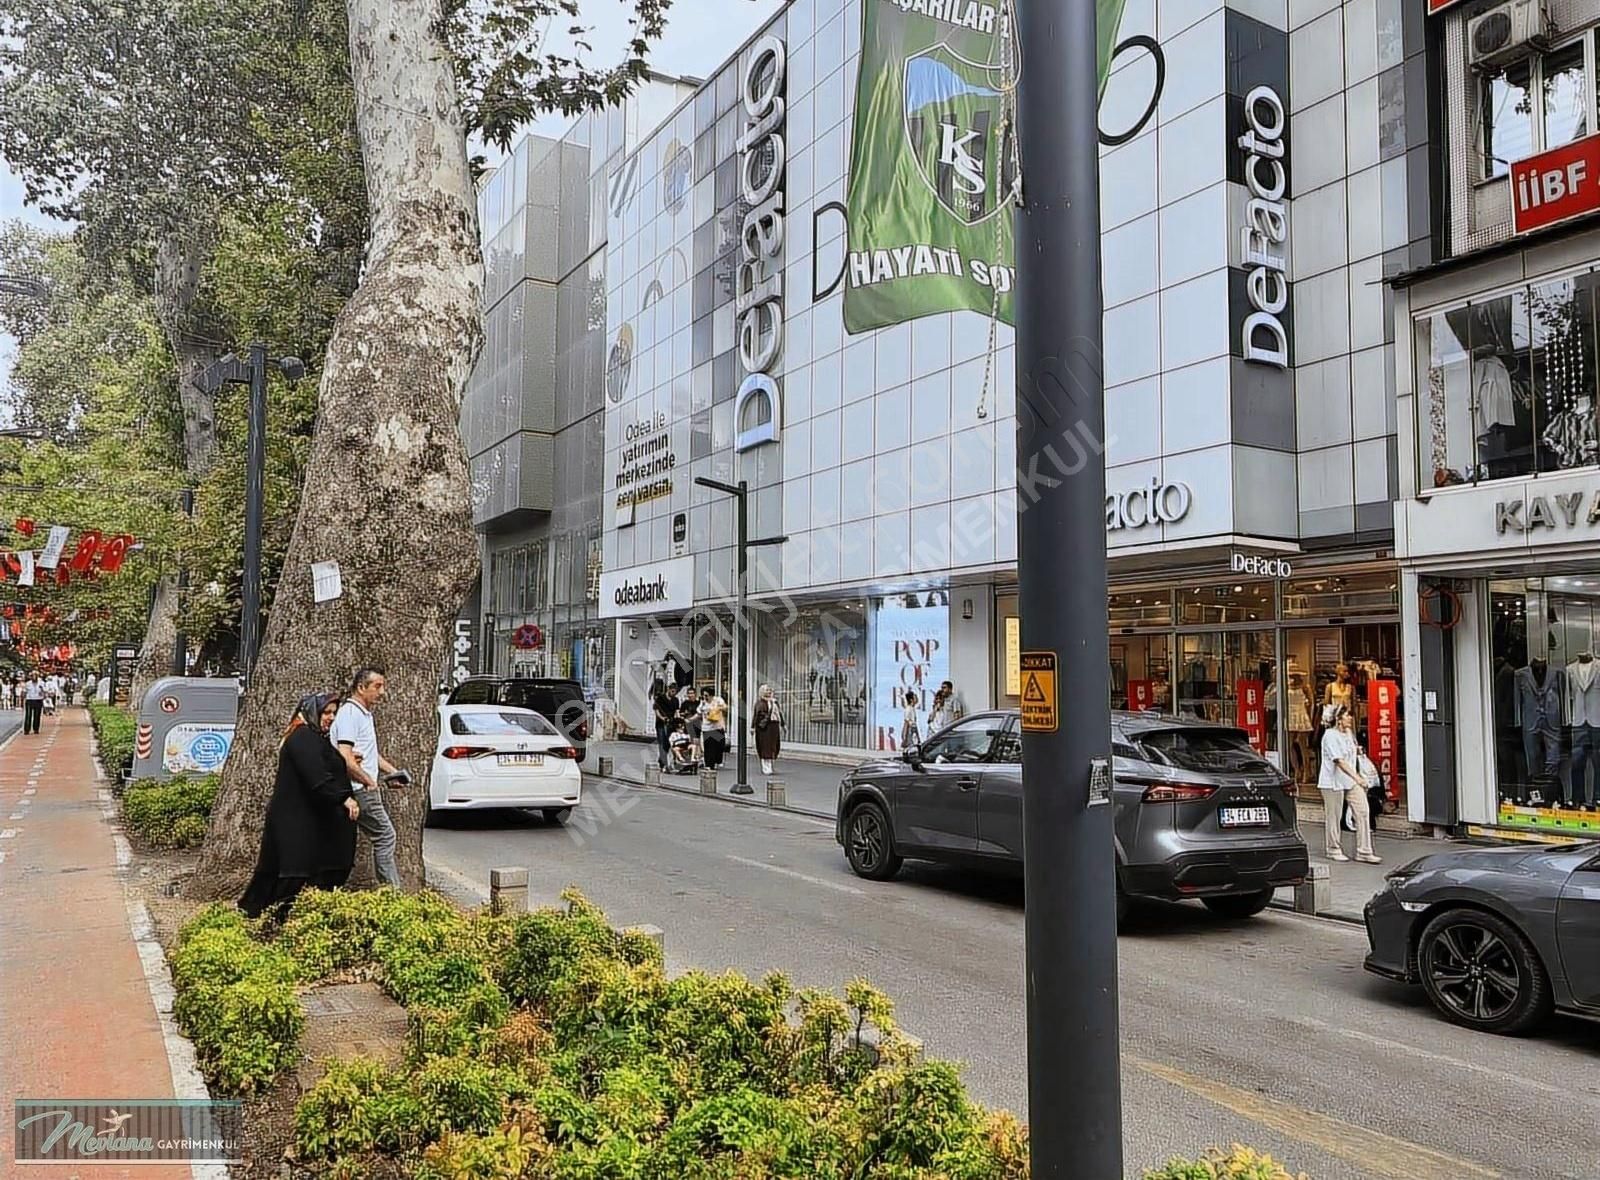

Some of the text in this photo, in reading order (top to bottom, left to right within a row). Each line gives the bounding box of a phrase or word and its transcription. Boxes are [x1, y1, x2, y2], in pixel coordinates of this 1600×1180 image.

[735, 34, 786, 453] DeFacto
[1238, 85, 1287, 368] DeFacto
[969, 259, 1015, 294] SO
[625, 421, 651, 442] Odea
[622, 433, 669, 468] yatırımın
[616, 452, 676, 489] merkezinde
[1106, 477, 1192, 530] acto
[1233, 553, 1292, 578] DeFacto
[452, 619, 472, 688] OTON
[891, 639, 940, 663] POP
[900, 663, 932, 685] OF
